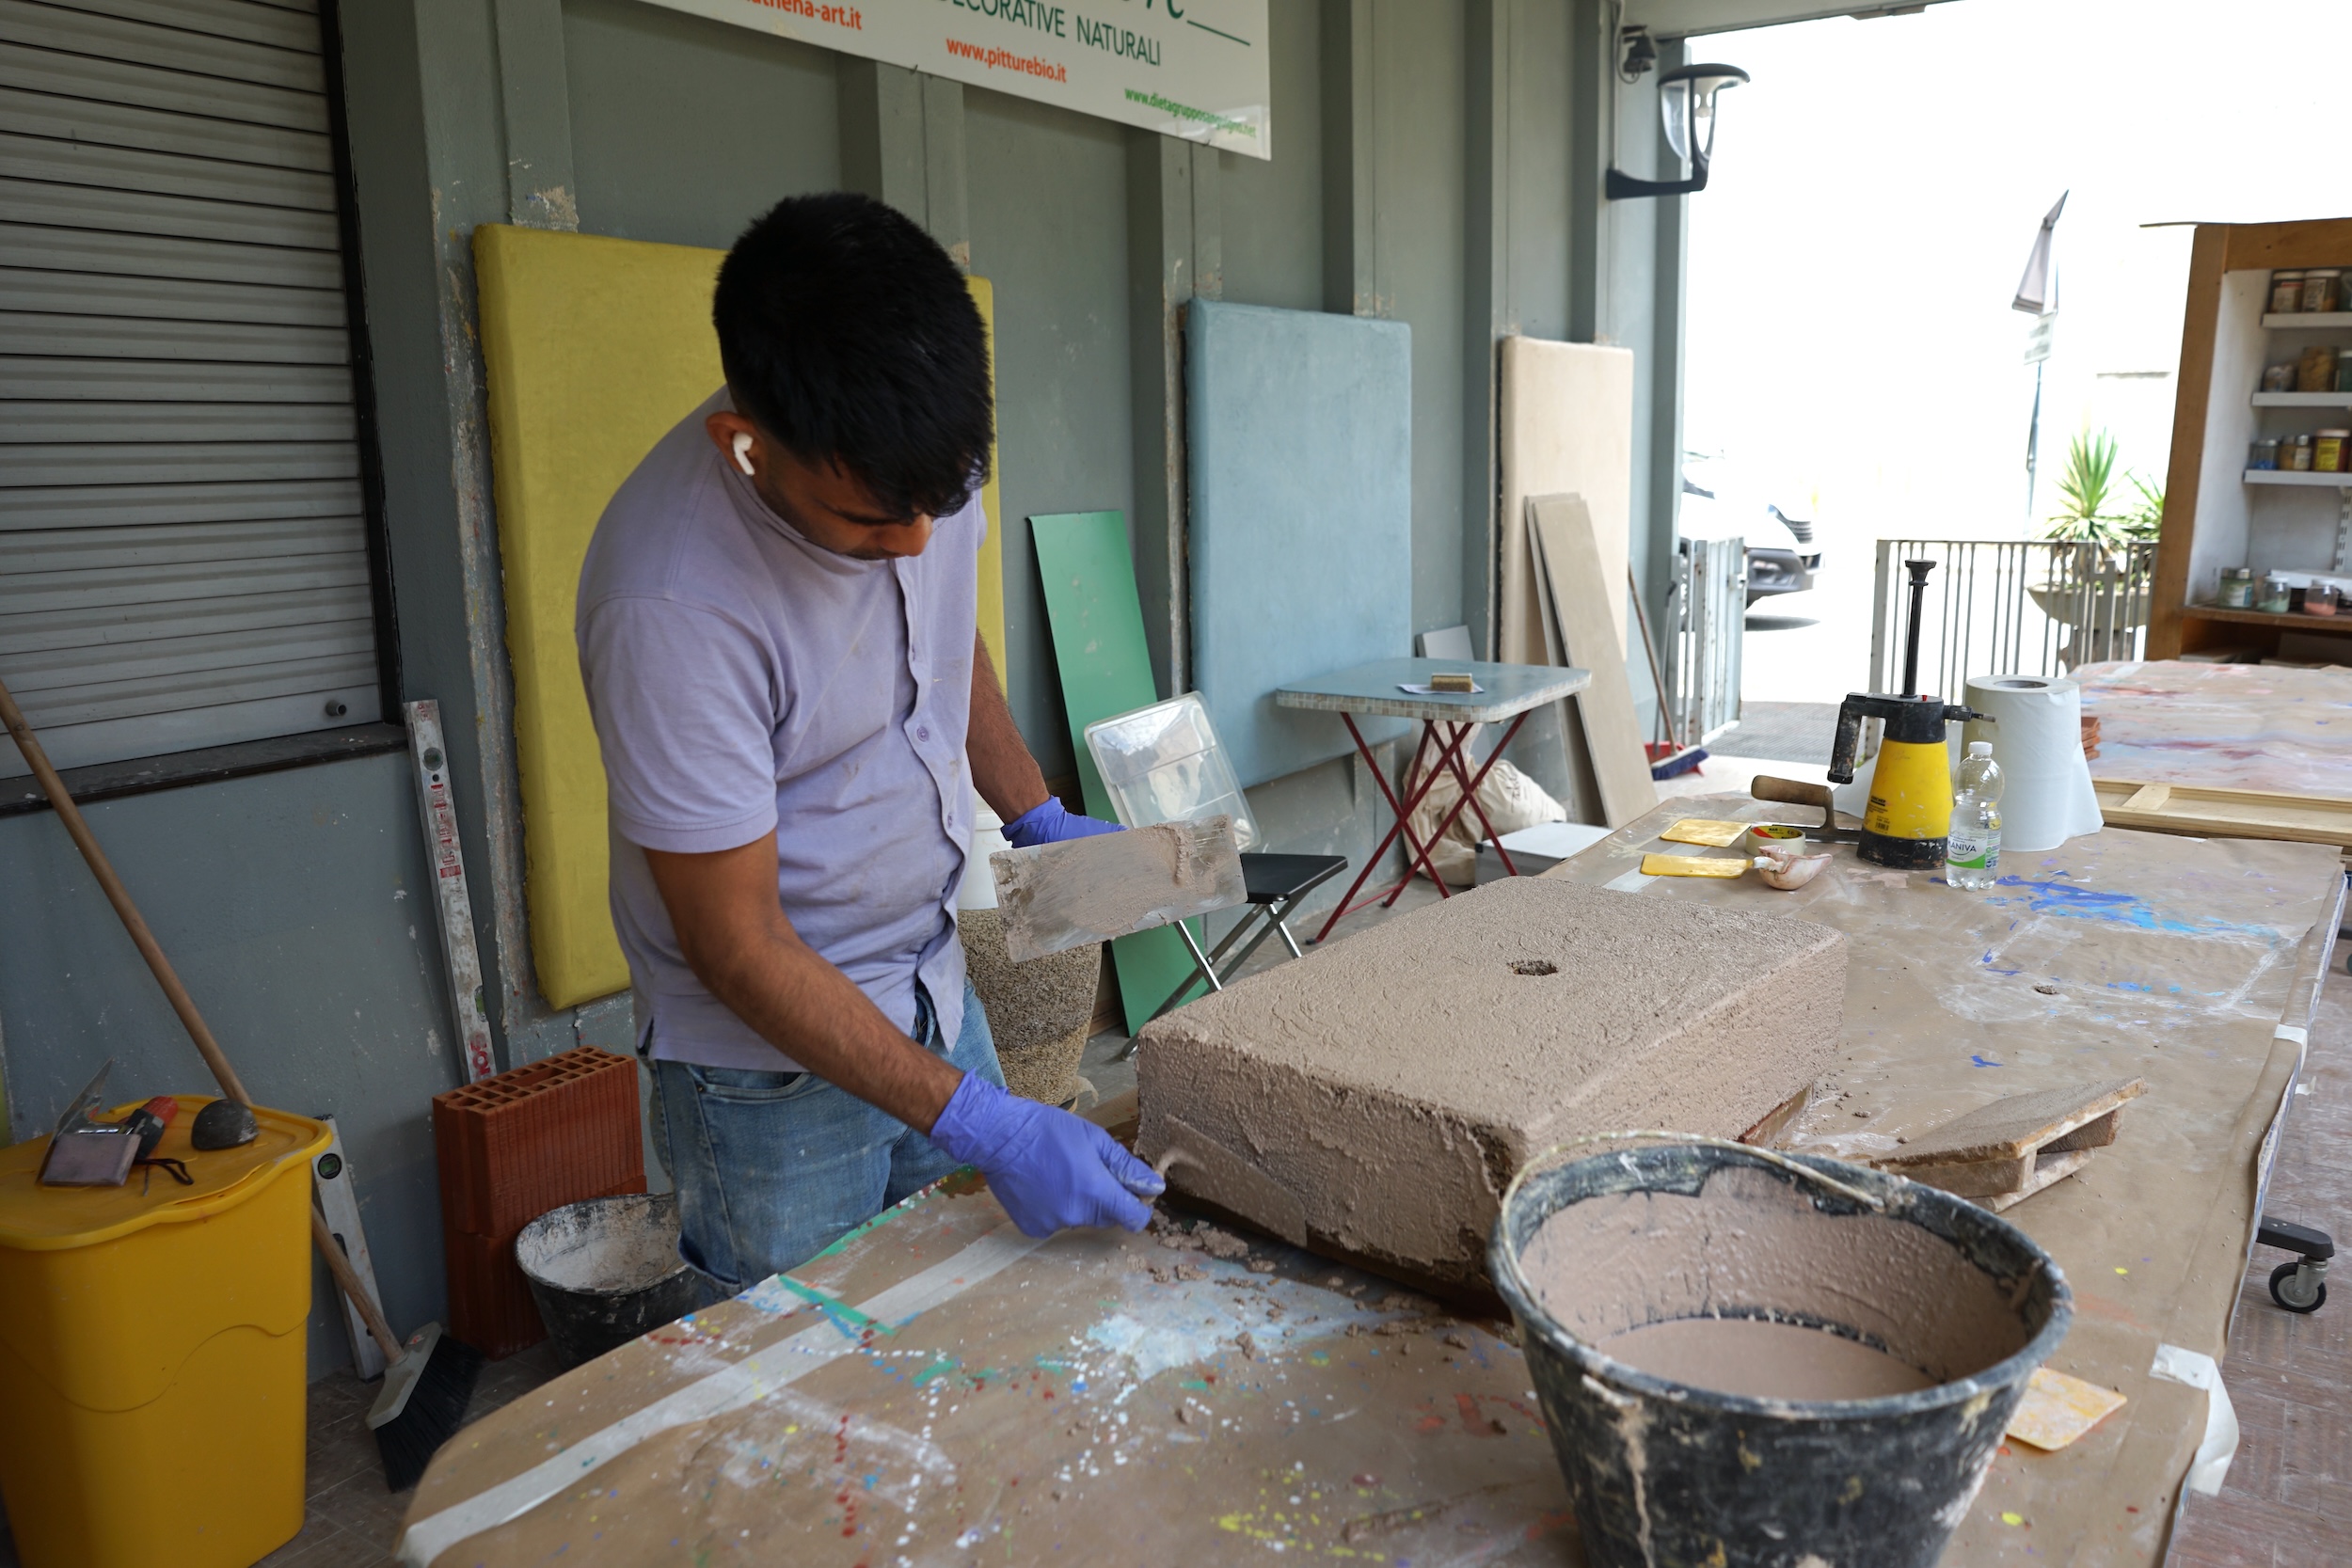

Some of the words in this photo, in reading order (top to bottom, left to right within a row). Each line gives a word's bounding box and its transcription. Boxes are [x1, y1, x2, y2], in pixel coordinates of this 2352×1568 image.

[752, 0, 863, 30] ena-art.it
[944, 0, 1066, 38] ORATIVE
[1076, 15, 1161, 67] NATURALI
[946, 38, 1067, 83] www.pitturebio.it
